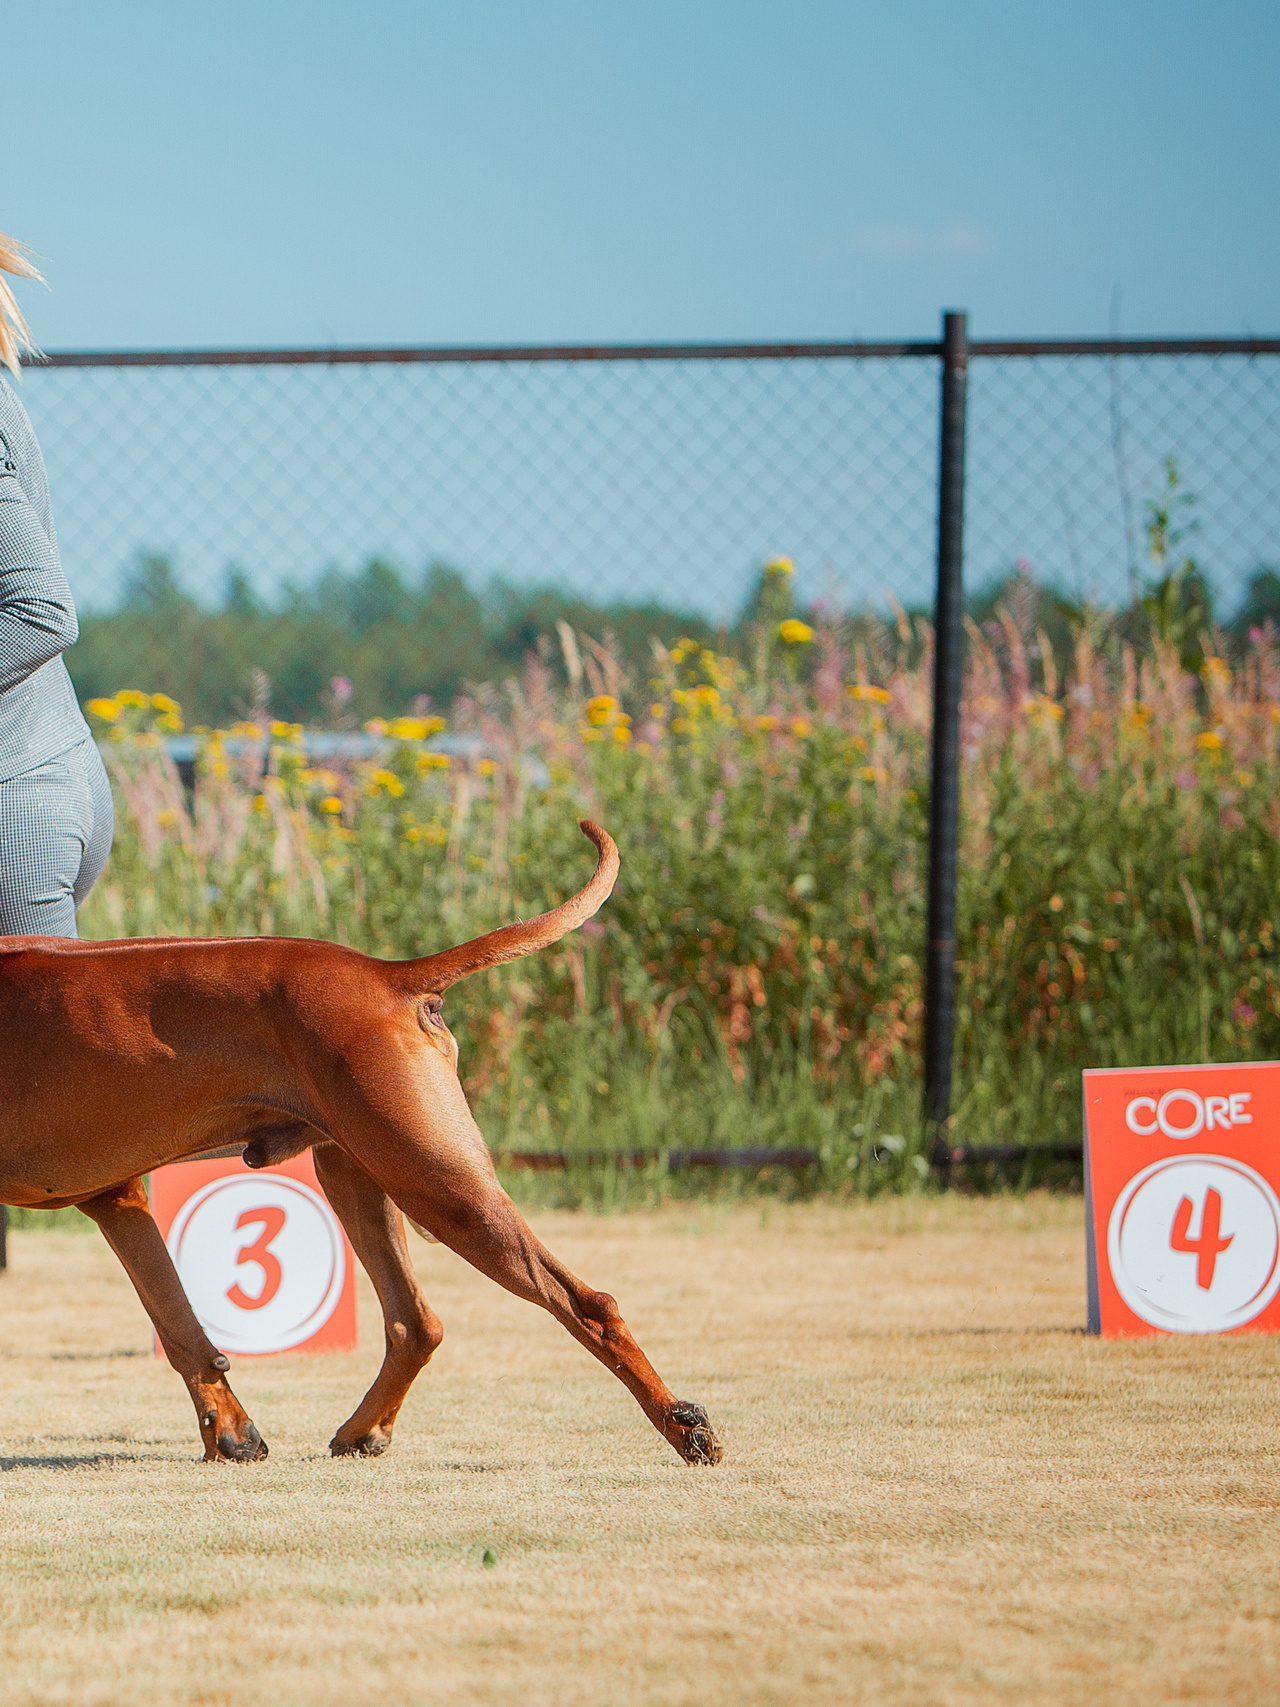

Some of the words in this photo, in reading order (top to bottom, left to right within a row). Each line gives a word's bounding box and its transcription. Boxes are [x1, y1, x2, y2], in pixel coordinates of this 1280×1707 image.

[1125, 1088, 1253, 1140] CORE
[226, 1206, 286, 1311] 3
[1170, 1185, 1235, 1291] 4
